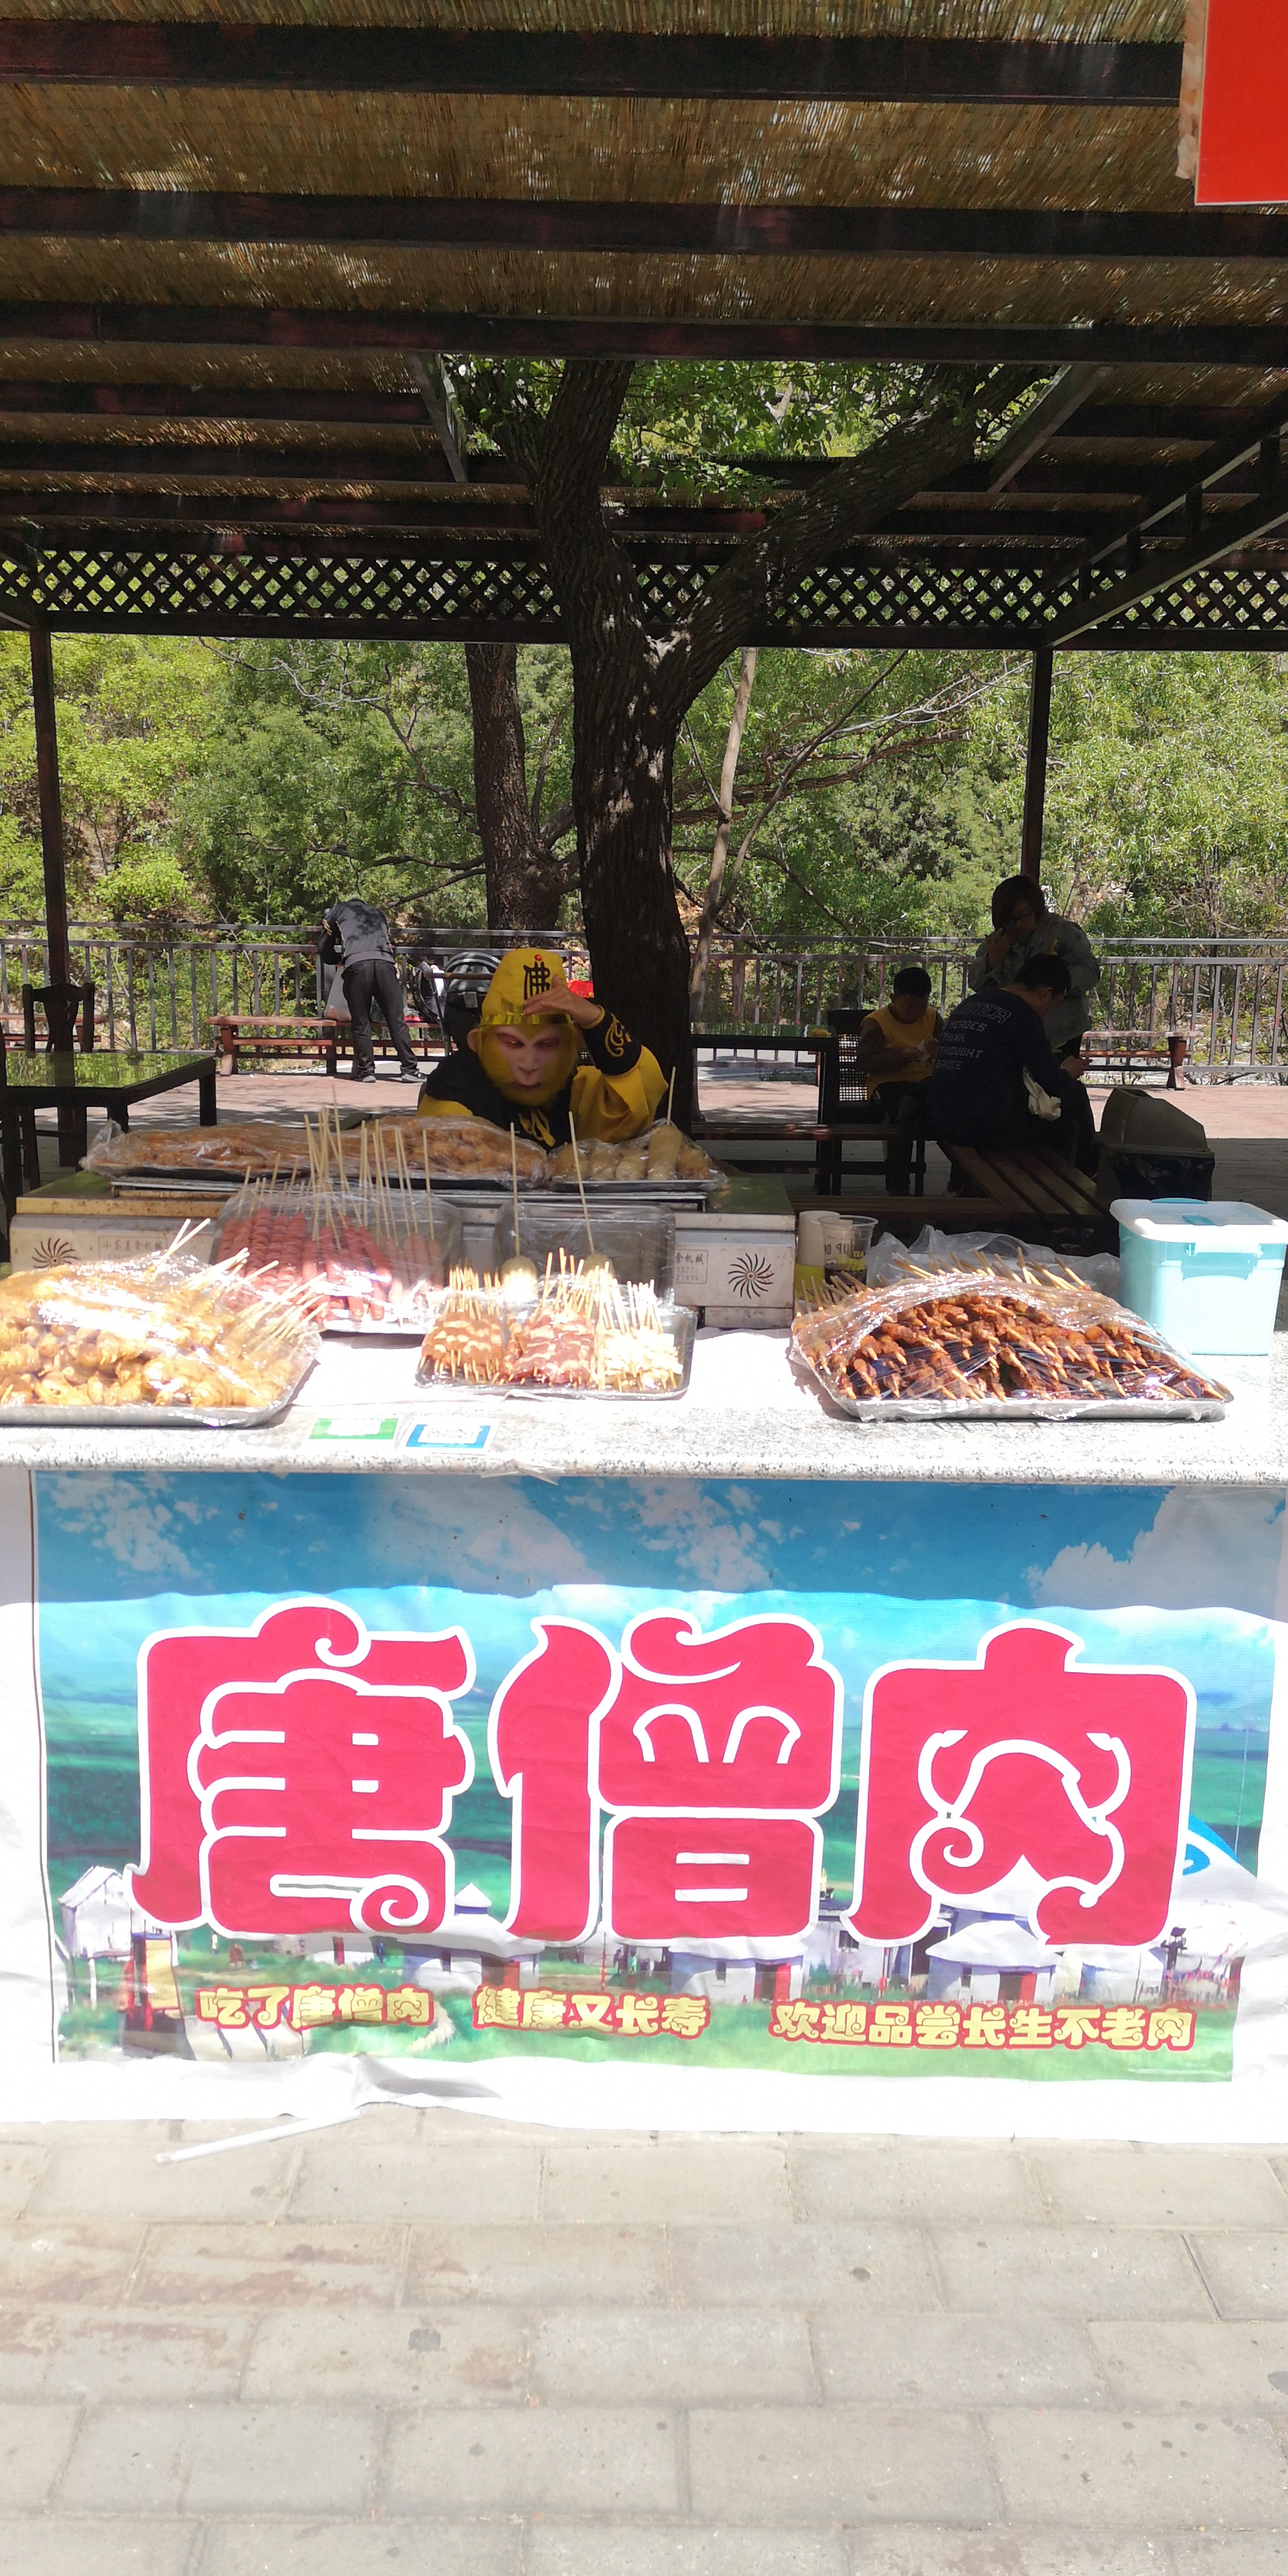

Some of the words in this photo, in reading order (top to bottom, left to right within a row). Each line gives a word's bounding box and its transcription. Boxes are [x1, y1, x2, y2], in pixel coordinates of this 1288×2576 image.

[126, 1605, 1193, 1946] 唐僧肉
[197, 1983, 432, 2031] 吃了唐僧肉
[473, 1985, 709, 2038] 健康又长寿
[771, 2000, 1195, 2050] 欢迎品尝长生不老肉
